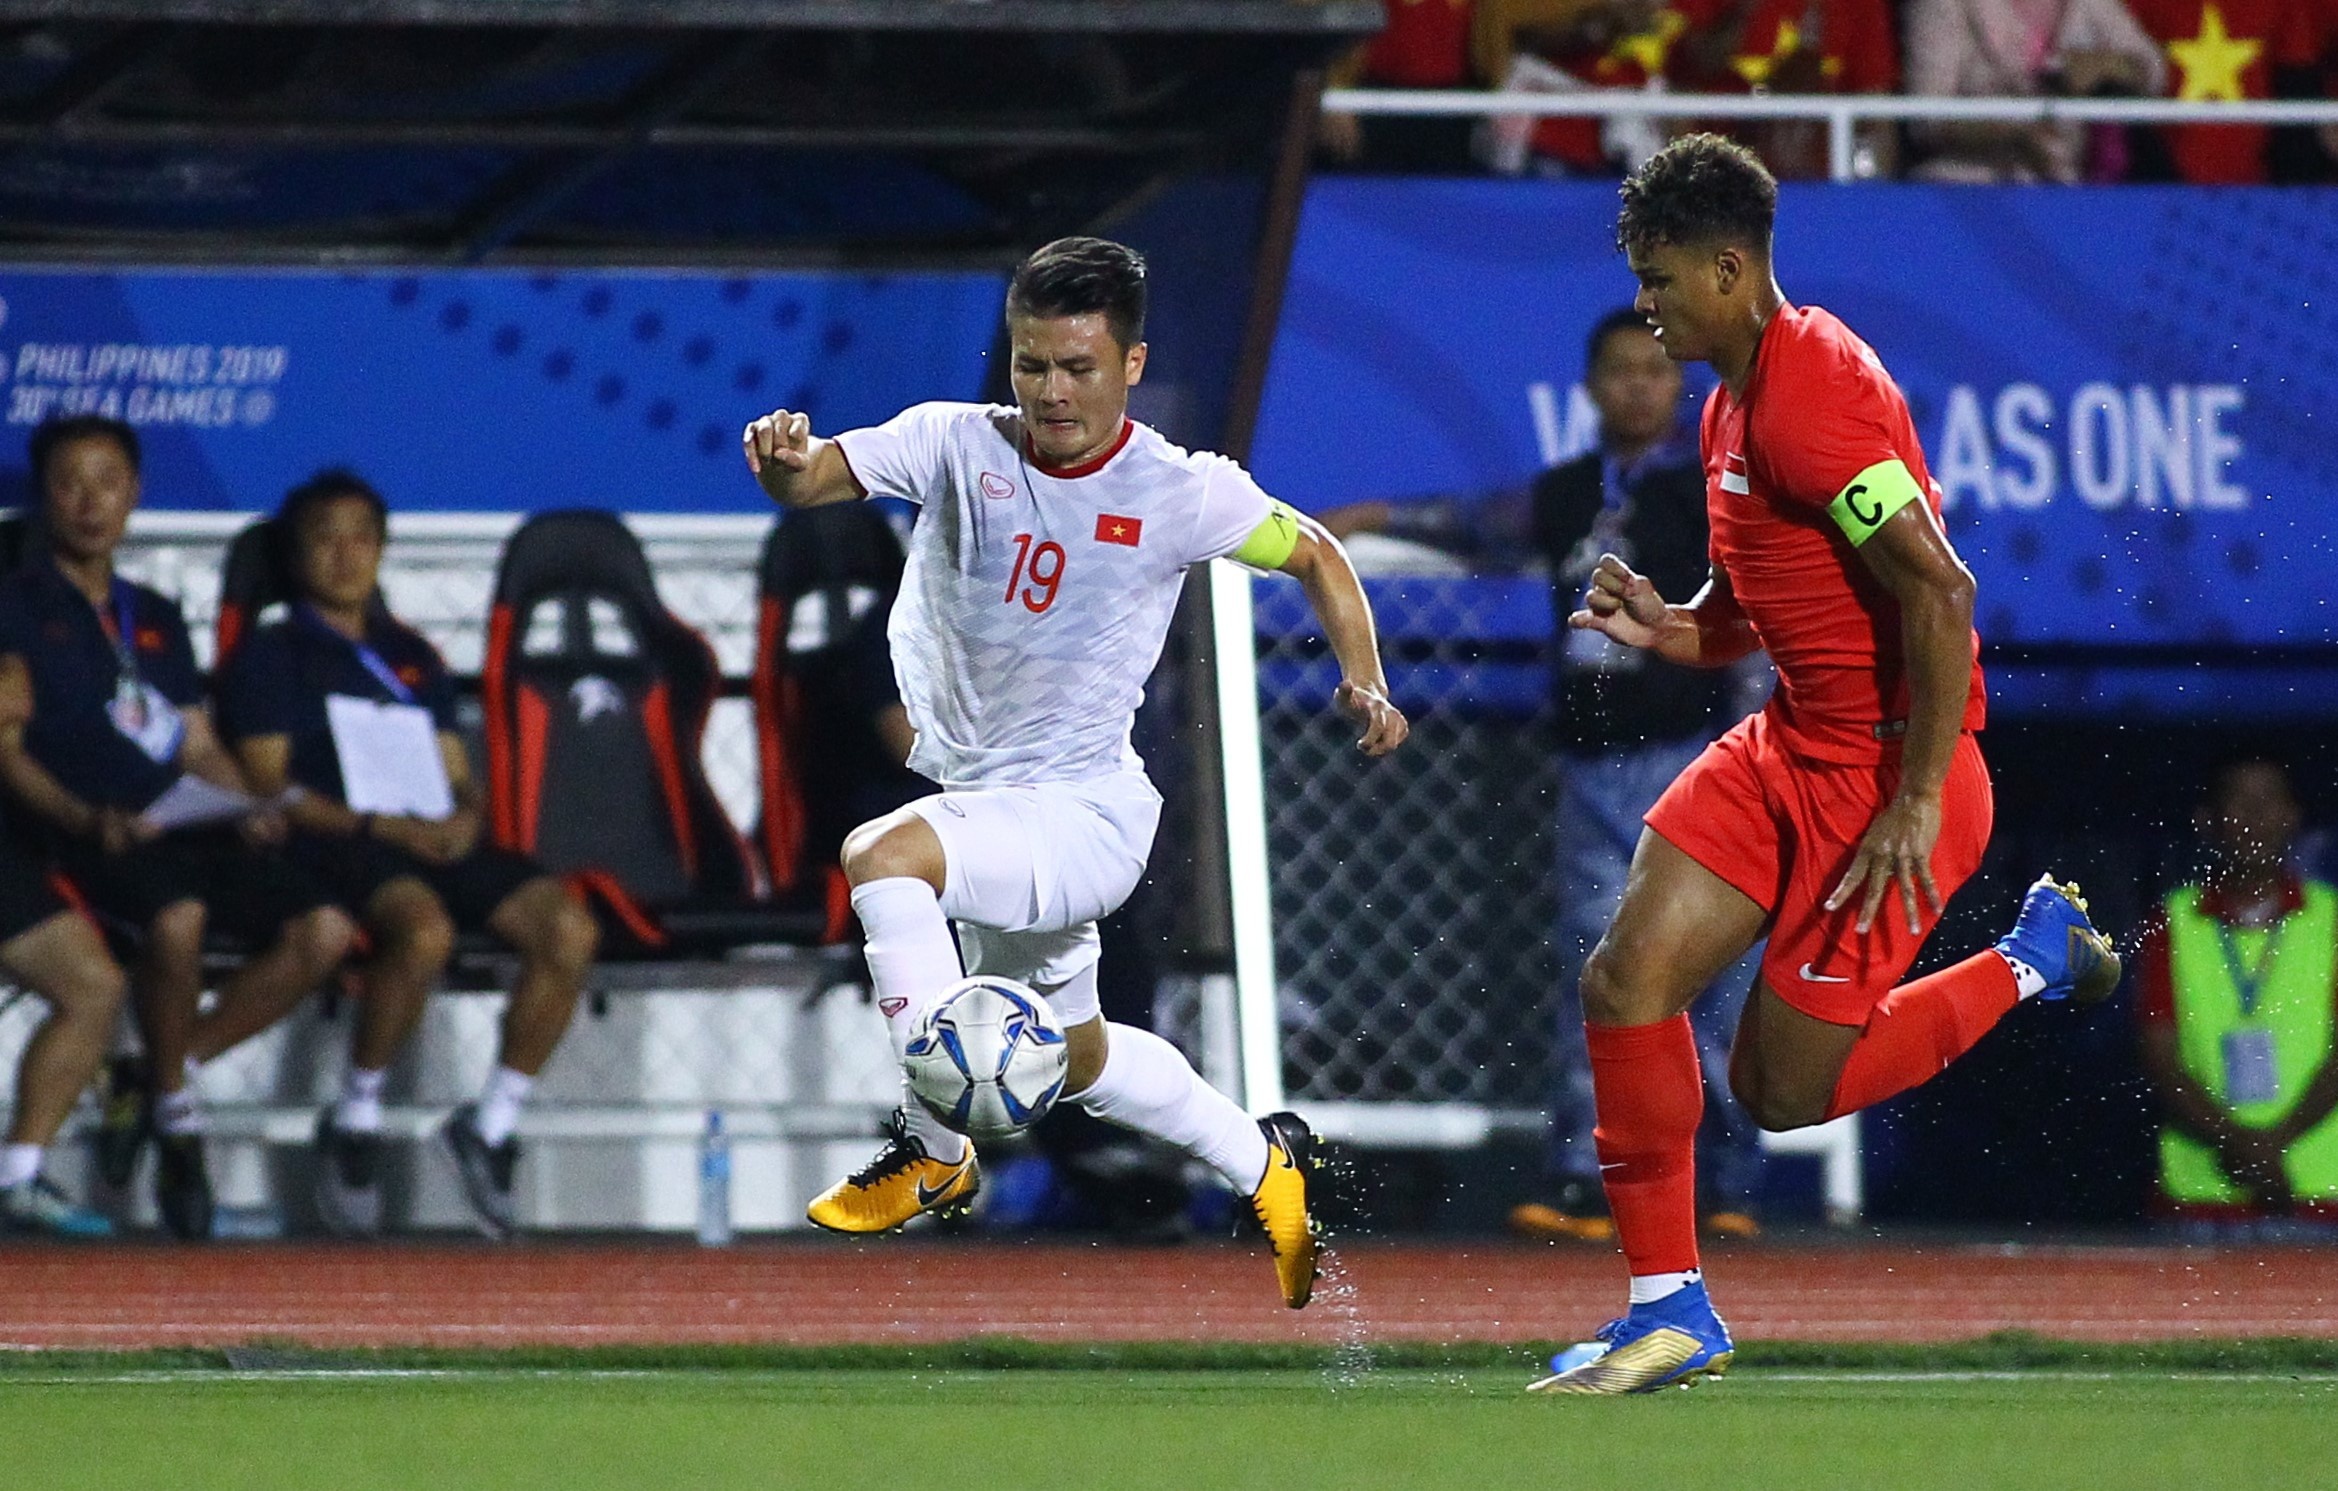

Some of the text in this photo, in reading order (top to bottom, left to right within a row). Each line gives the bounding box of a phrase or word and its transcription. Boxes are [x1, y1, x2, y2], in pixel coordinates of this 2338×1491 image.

[14, 342, 288, 385] PHILIPPINES 2019
[126, 386, 239, 427] GAMES
[1936, 384, 2056, 508] AS
[2070, 382, 2248, 508] ONE
[1844, 484, 1883, 526] C
[1004, 533, 1066, 614] 19
